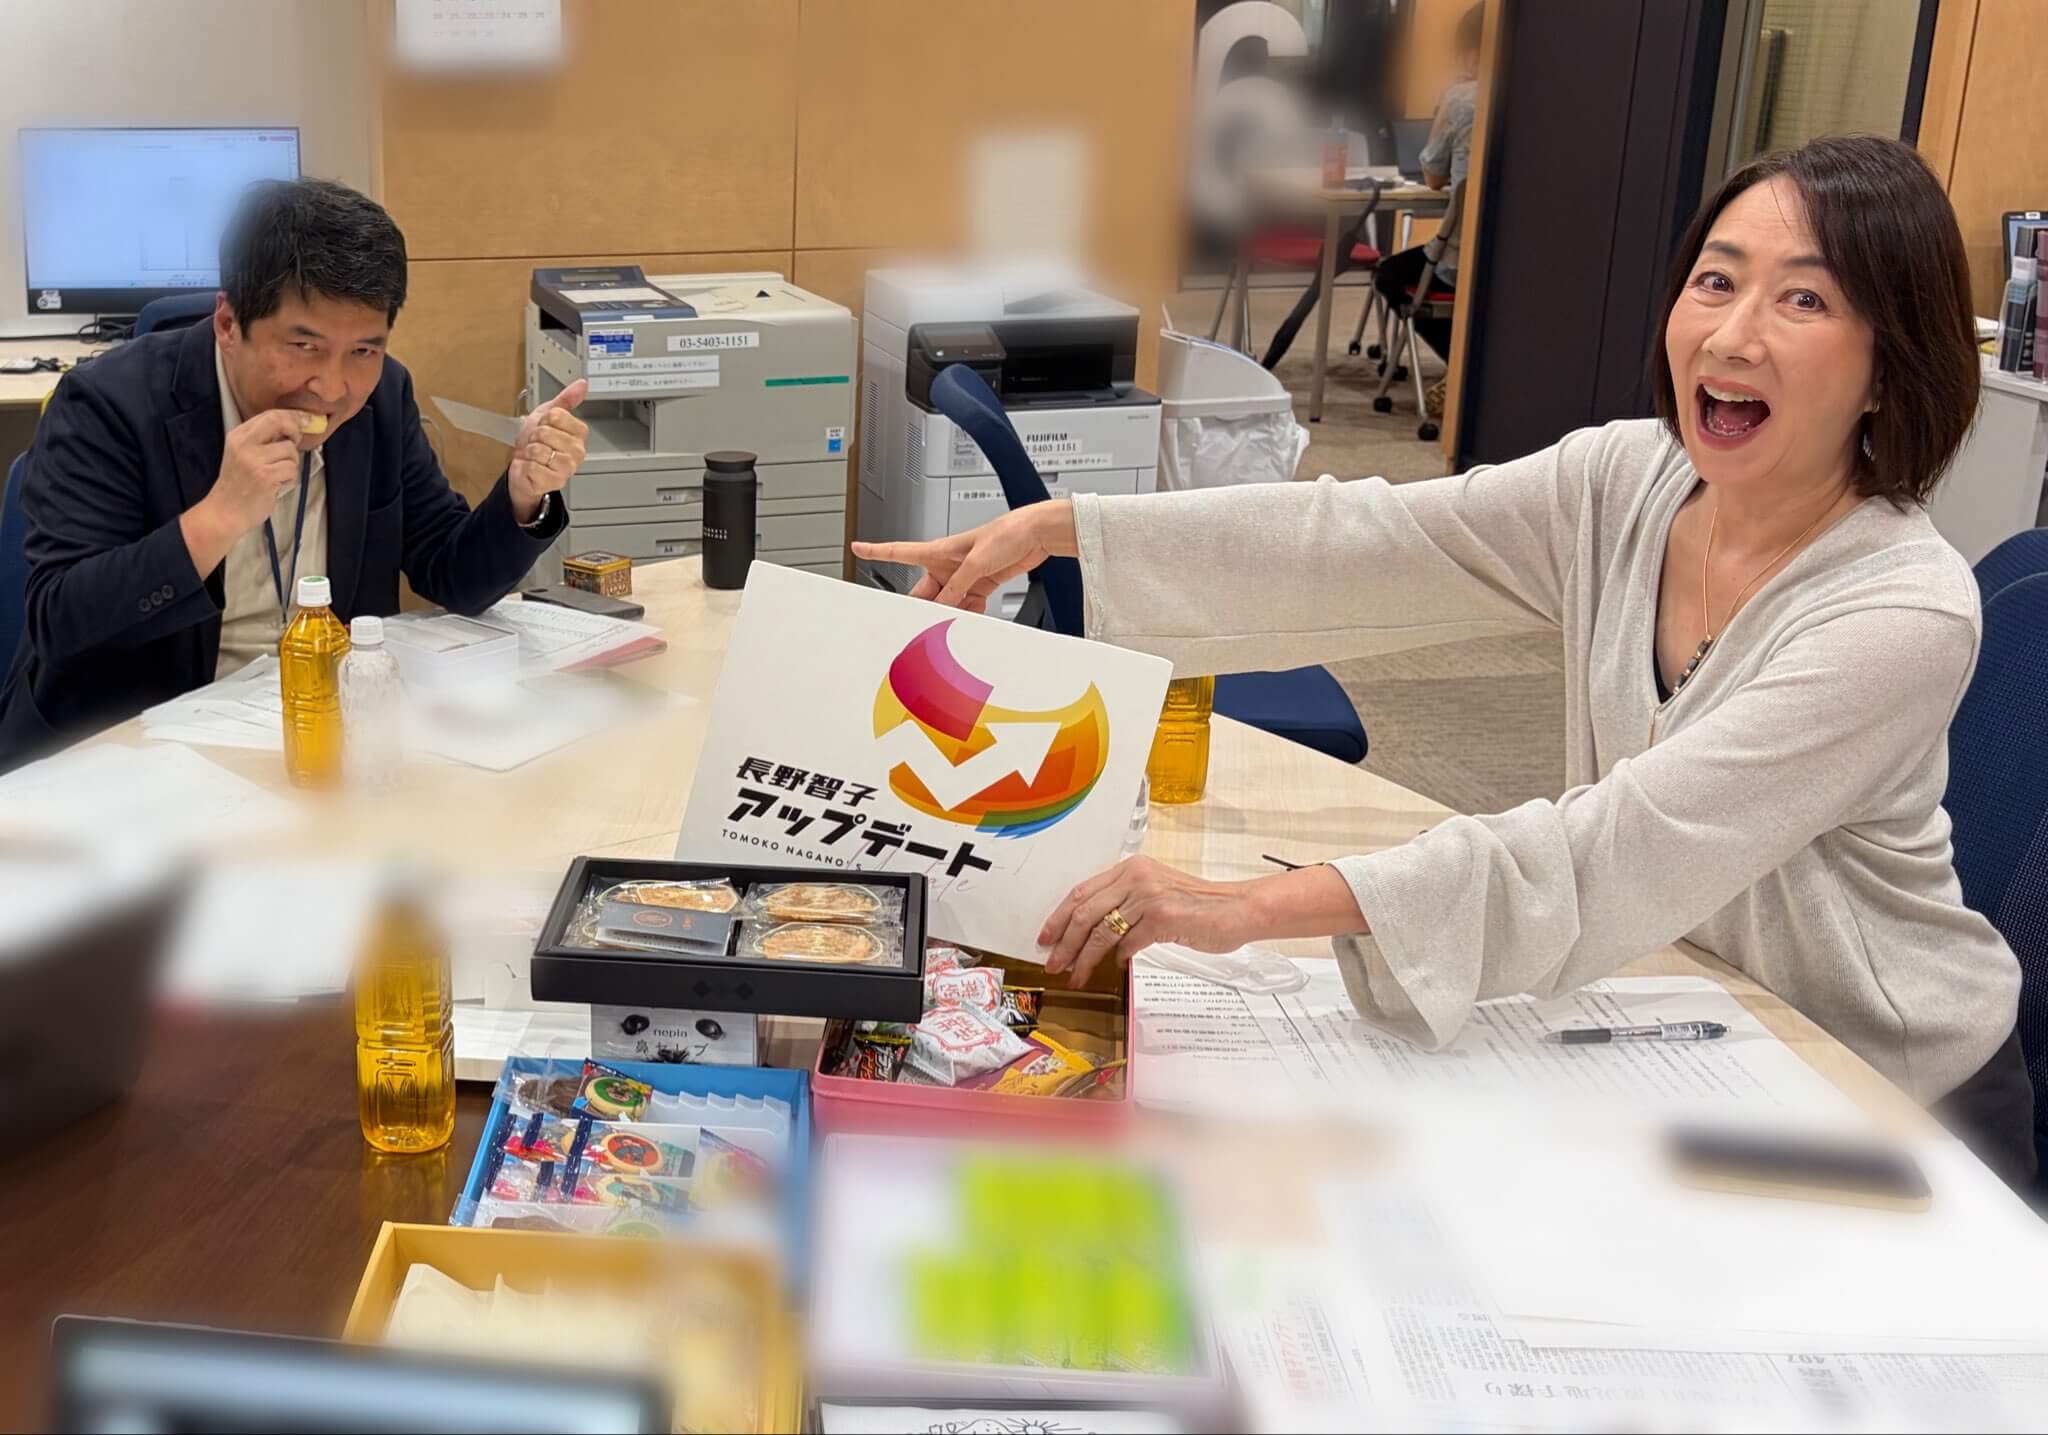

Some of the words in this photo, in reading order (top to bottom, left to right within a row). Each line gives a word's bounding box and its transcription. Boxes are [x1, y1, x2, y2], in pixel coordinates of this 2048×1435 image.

[679, 335, 749, 349] 03-5403-1151
[1026, 432, 1069, 442] FUJIFILM
[736, 756, 880, 808] 長野智子
[727, 787, 993, 878] アップデート
[721, 828, 779, 851] TOMOKO
[785, 844, 863, 872] NAGANO'S
[653, 1027, 689, 1039] nepia
